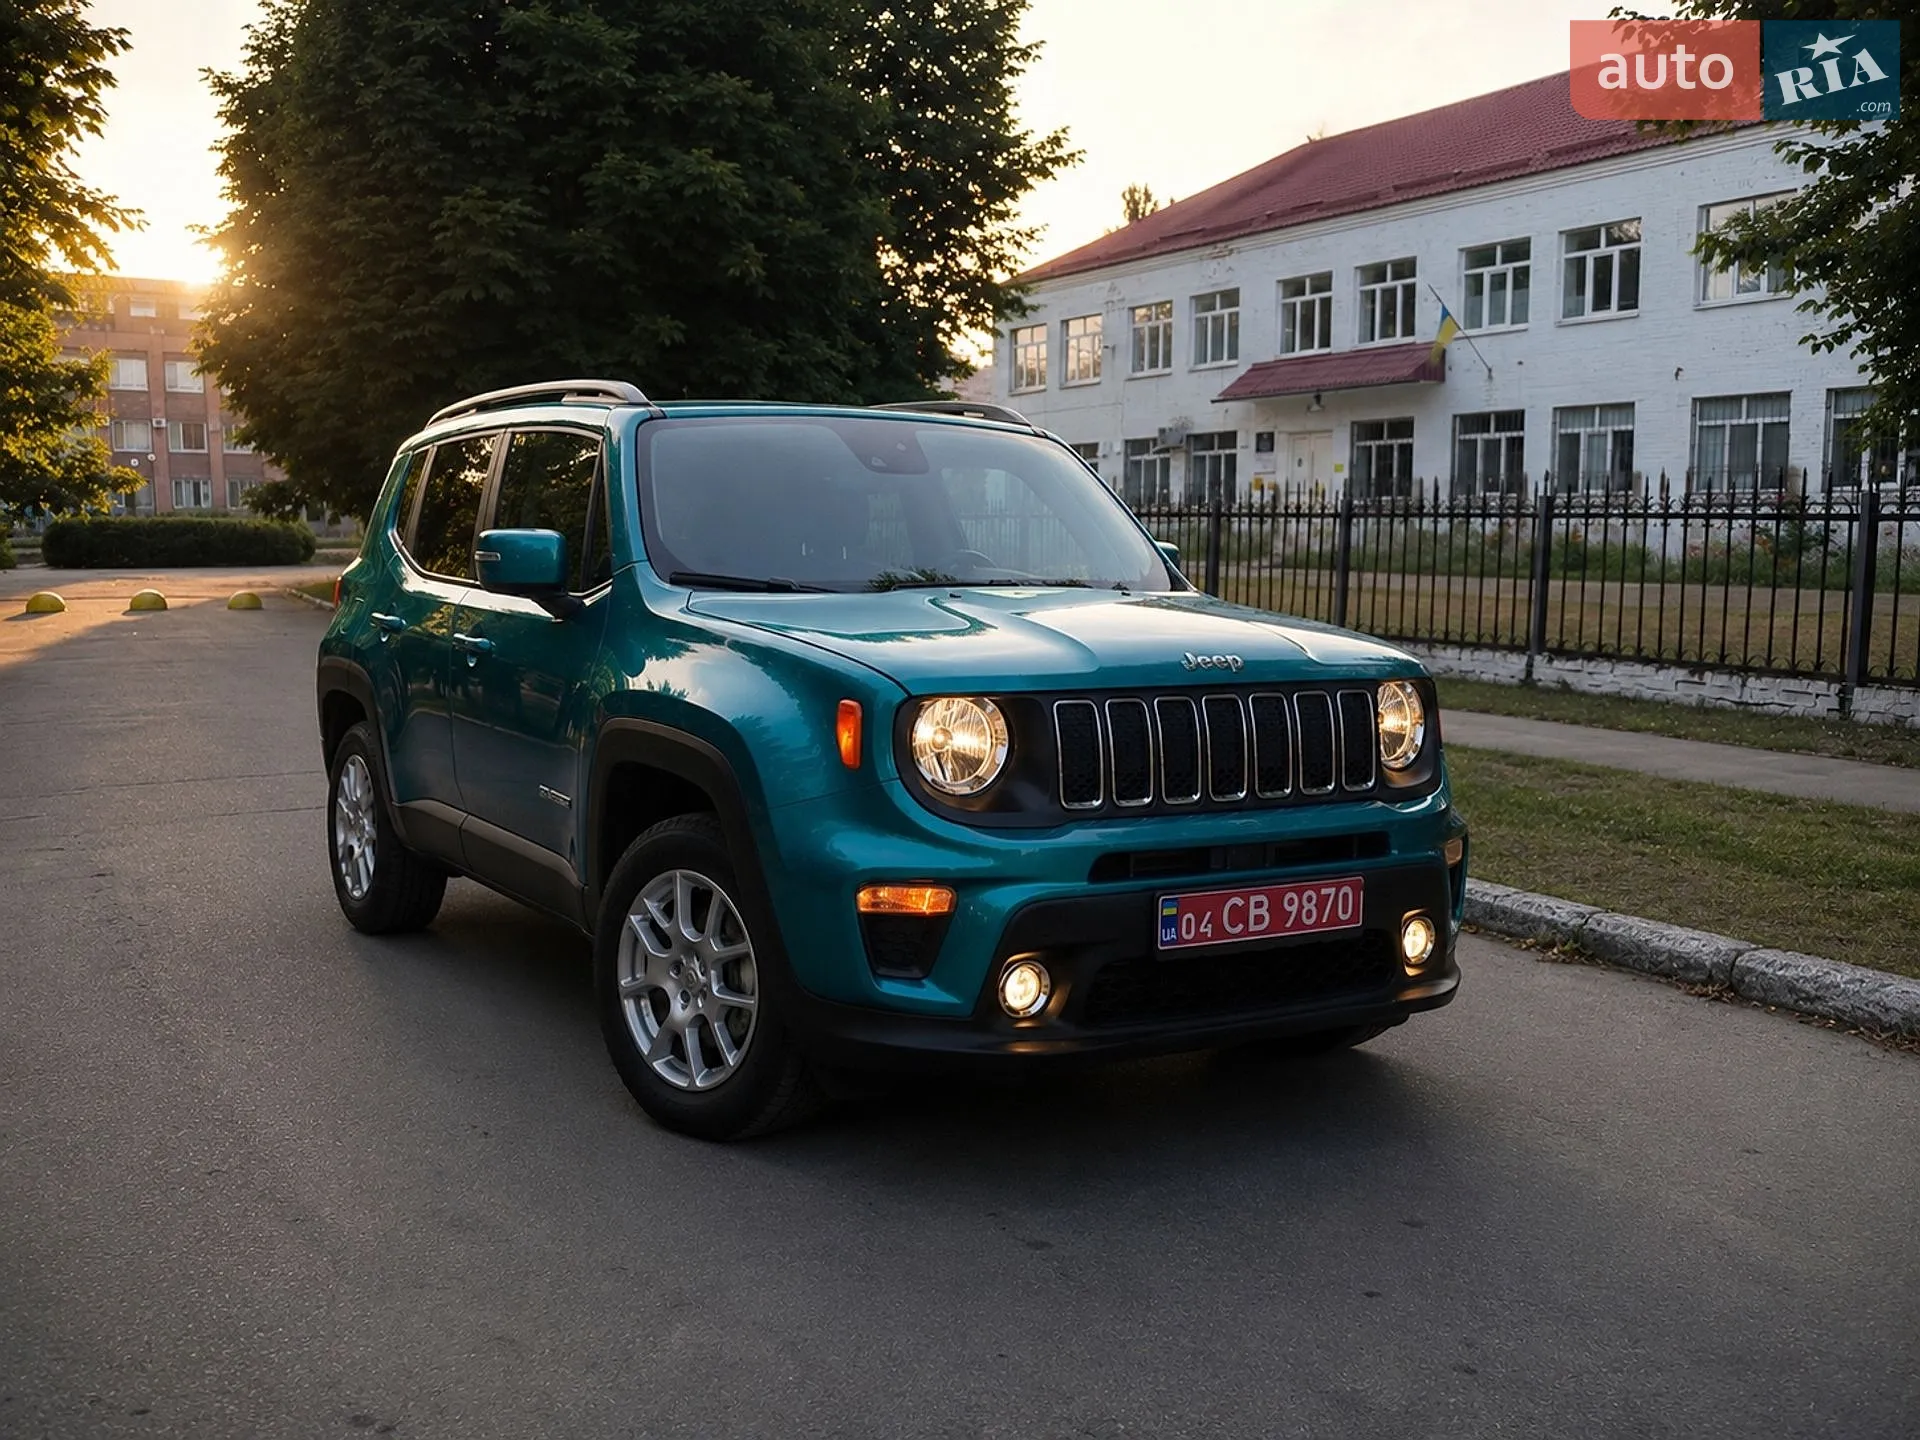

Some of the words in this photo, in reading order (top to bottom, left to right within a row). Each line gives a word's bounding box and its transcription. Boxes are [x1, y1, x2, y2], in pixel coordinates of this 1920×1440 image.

[1180, 652, 1244, 672] Jeep
[1181, 911, 1213, 940] 04
[1222, 894, 1270, 935] CB
[1283, 885, 1353, 928] 9870
[1161, 927, 1177, 942] UA
